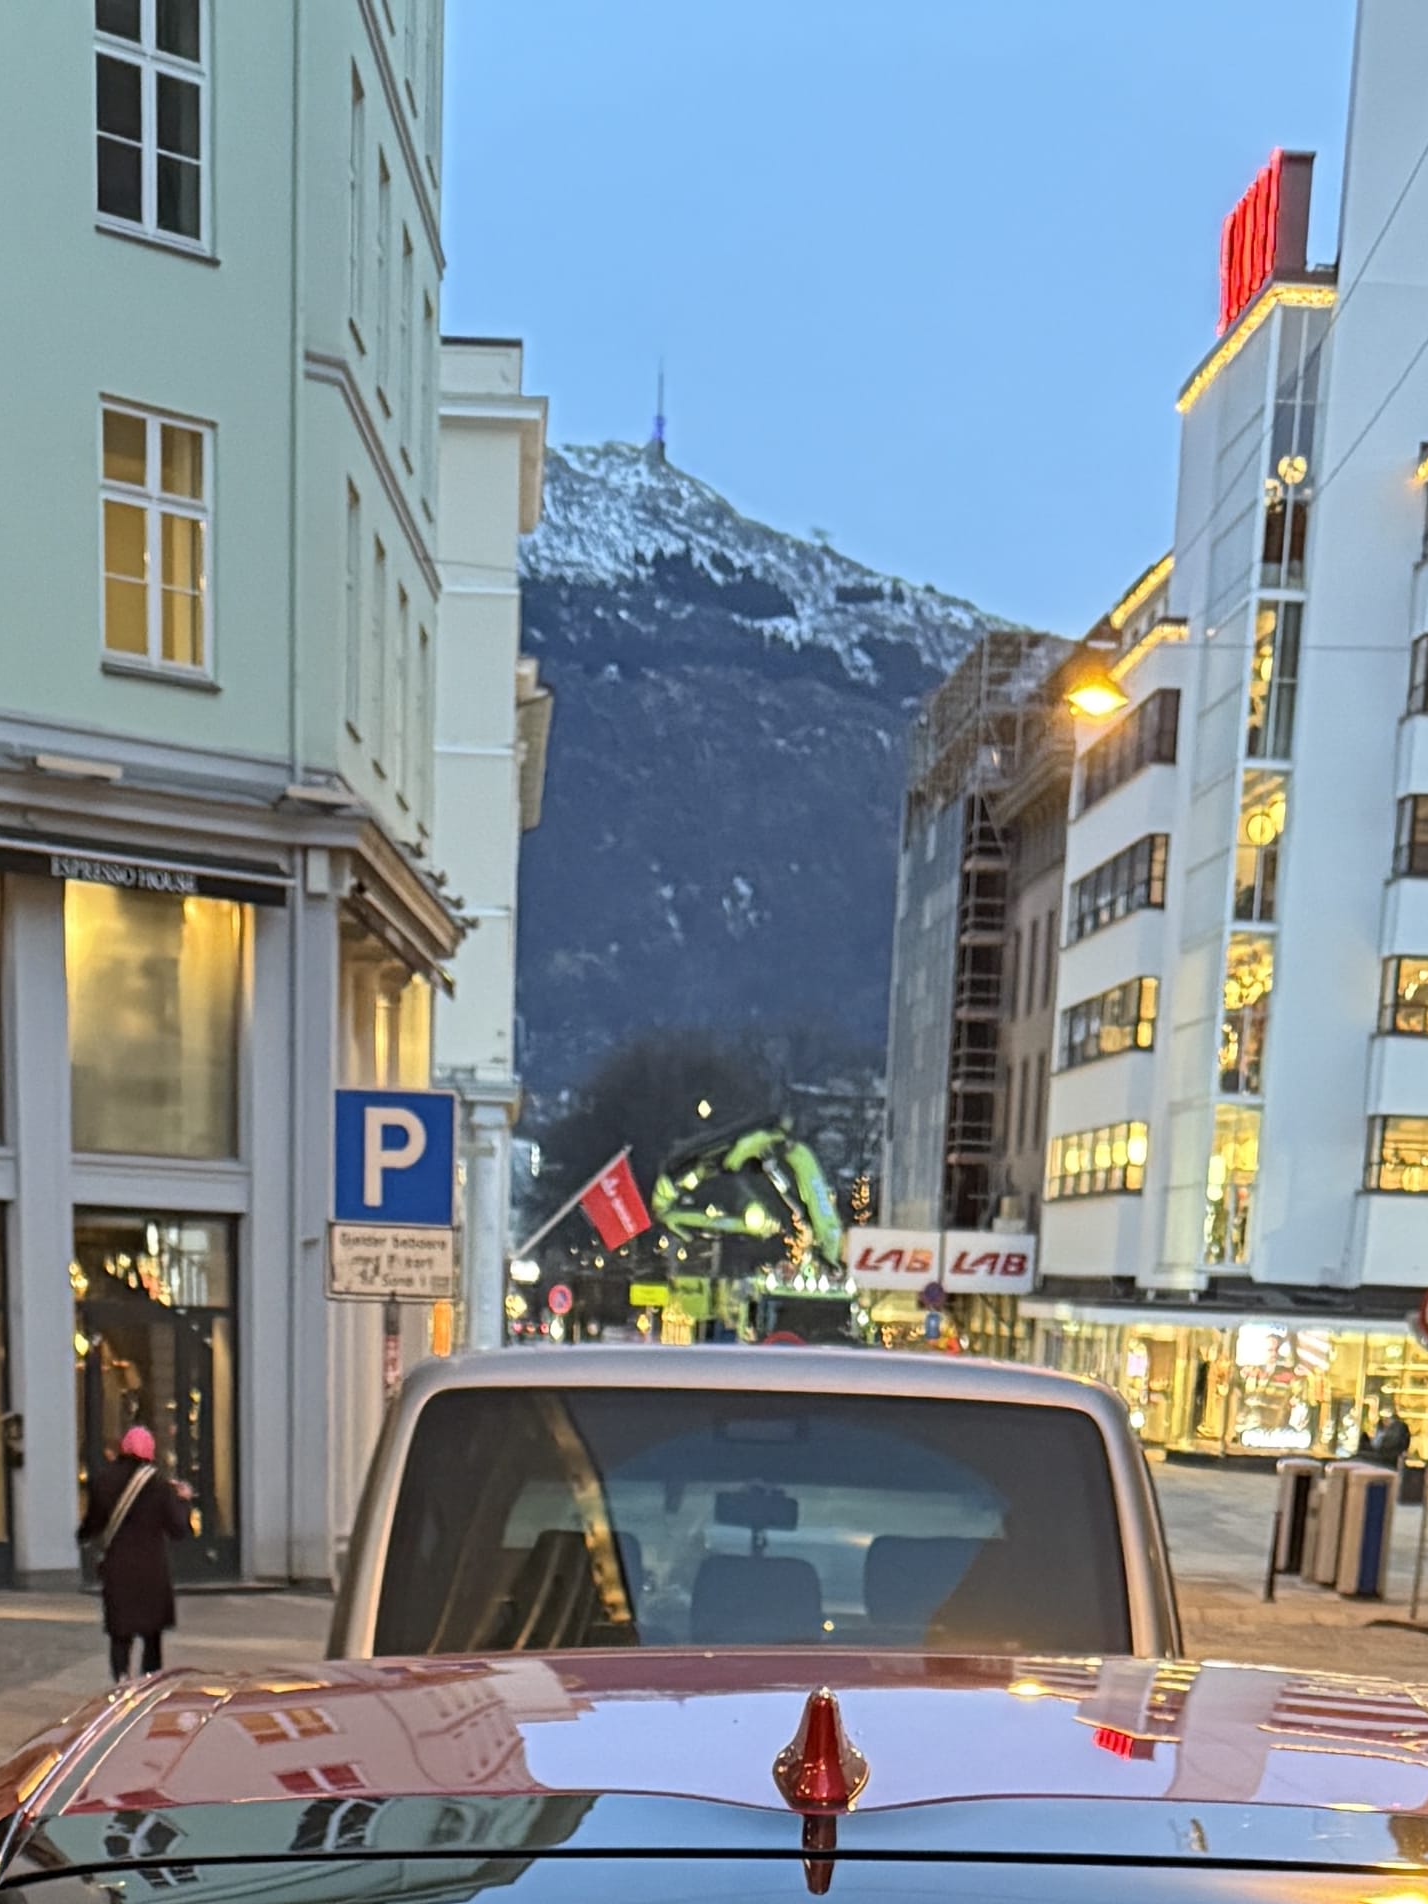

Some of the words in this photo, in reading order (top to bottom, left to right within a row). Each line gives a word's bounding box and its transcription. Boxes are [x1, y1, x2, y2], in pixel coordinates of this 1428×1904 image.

[50, 855, 137, 886] ESPRESSO
[138, 868, 200, 894] HOUSE
[363, 1106, 427, 1207] P
[854, 1247, 934, 1274] LAB
[949, 1250, 1029, 1277] LAB
